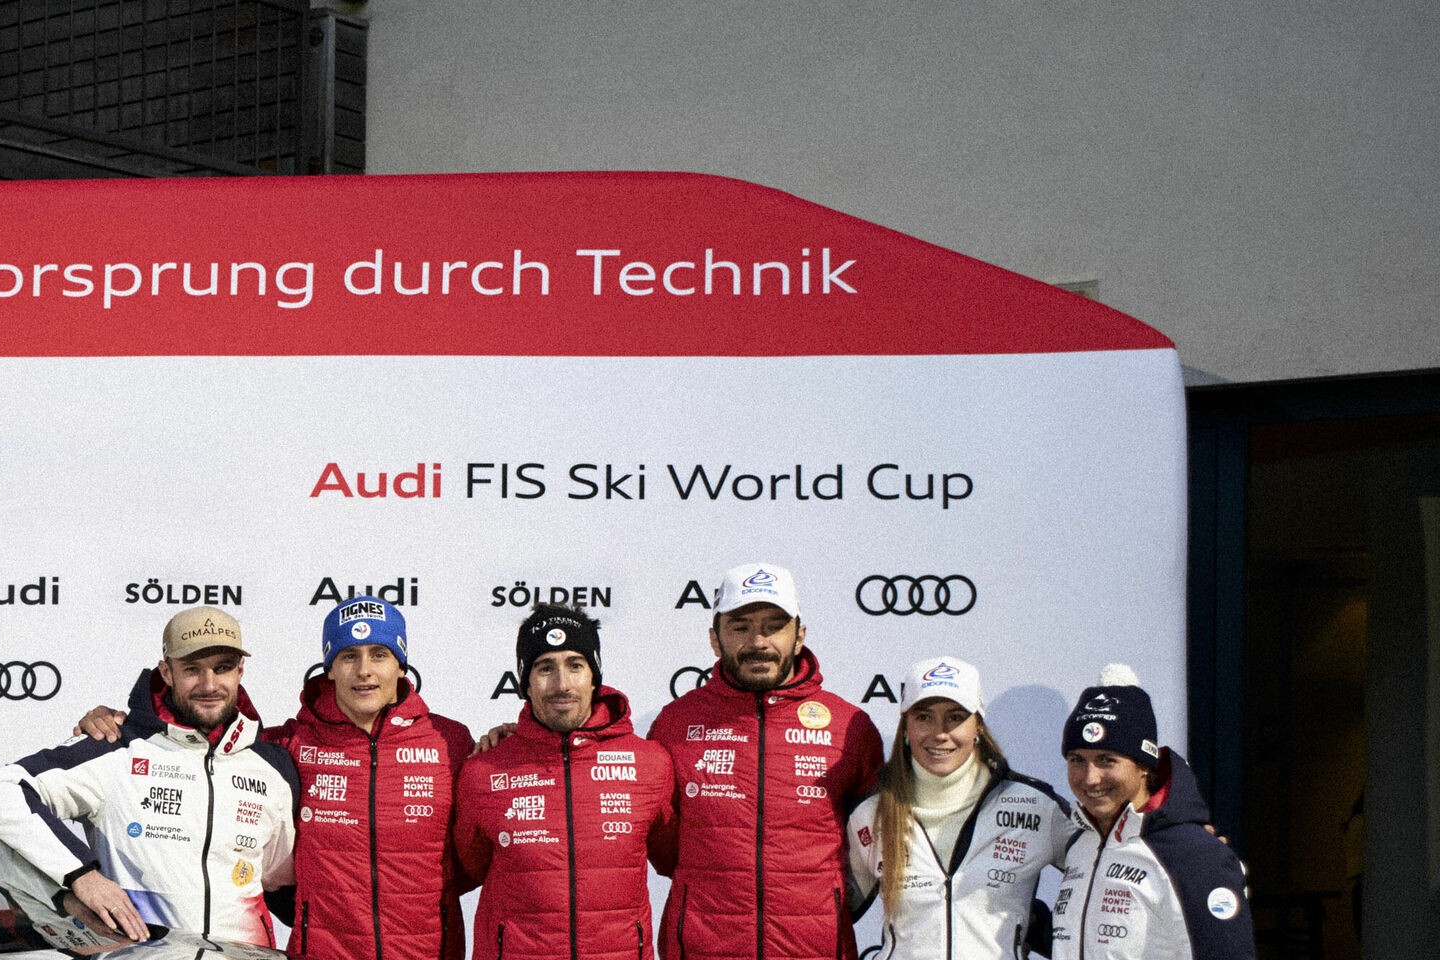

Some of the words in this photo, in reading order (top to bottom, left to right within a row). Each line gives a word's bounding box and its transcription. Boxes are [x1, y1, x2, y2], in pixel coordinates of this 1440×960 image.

[343, 249, 551, 296] durch
[576, 247, 858, 296] Technik
[310, 462, 442, 499] Audi
[465, 462, 546, 499] FIS
[567, 463, 646, 500] Ski
[667, 463, 844, 500] World
[867, 463, 974, 509] Cup
[125, 578, 242, 605] SÖLDEN
[491, 581, 612, 608] SÖLDEN
[340, 602, 383, 619] TIGNES
[181, 627, 236, 640] CIMALPES
[706, 728, 734, 736] CAISSE
[785, 728, 832, 746] COLMAR
[705, 734, 748, 743] D'EPARGNE
[318, 751, 345, 759] CAISSE
[396, 748, 439, 764] COLMAR
[598, 754, 633, 762] DOUANE
[703, 749, 735, 762] GREEN
[794, 755, 826, 763] SAVOIE
[152, 763, 181, 772] CAISSE
[318, 757, 360, 766] D'EPARGNE
[591, 766, 637, 781] COLMAR
[706, 761, 734, 775] WEEZ
[795, 769, 827, 778] BLANC
[152, 770, 196, 782] D'EPARGNE
[316, 774, 347, 788] GREEN
[510, 773, 539, 782] CAISSE
[231, 775, 268, 797] COLMAR
[510, 779, 555, 789] D'EPARGNE
[150, 786, 182, 802] GREEN
[319, 787, 347, 801] WEEZ
[238, 800, 263, 811] SAVOIE
[512, 795, 545, 809] GREEN
[1001, 797, 1037, 805] DOUANE
[153, 801, 181, 815] WEEZ
[315, 808, 350, 817] Auvergne-
[517, 807, 545, 820] WEEZ
[236, 815, 258, 826] BLANC
[314, 815, 358, 825] Rhône-Alpes
[996, 810, 1041, 832] COLMAR
[145, 824, 184, 833] Auvergne-
[513, 829, 549, 837] Auvergne-
[145, 831, 191, 842] Rhône-Alpes
[513, 835, 559, 845] Rhône-Alpes
[996, 837, 1027, 849] SAVOIE
[993, 852, 1024, 864] BLANC
[1106, 862, 1147, 885] COLMAR
[1104, 888, 1132, 898] SAVOIE
[1101, 905, 1130, 915] BLANC
